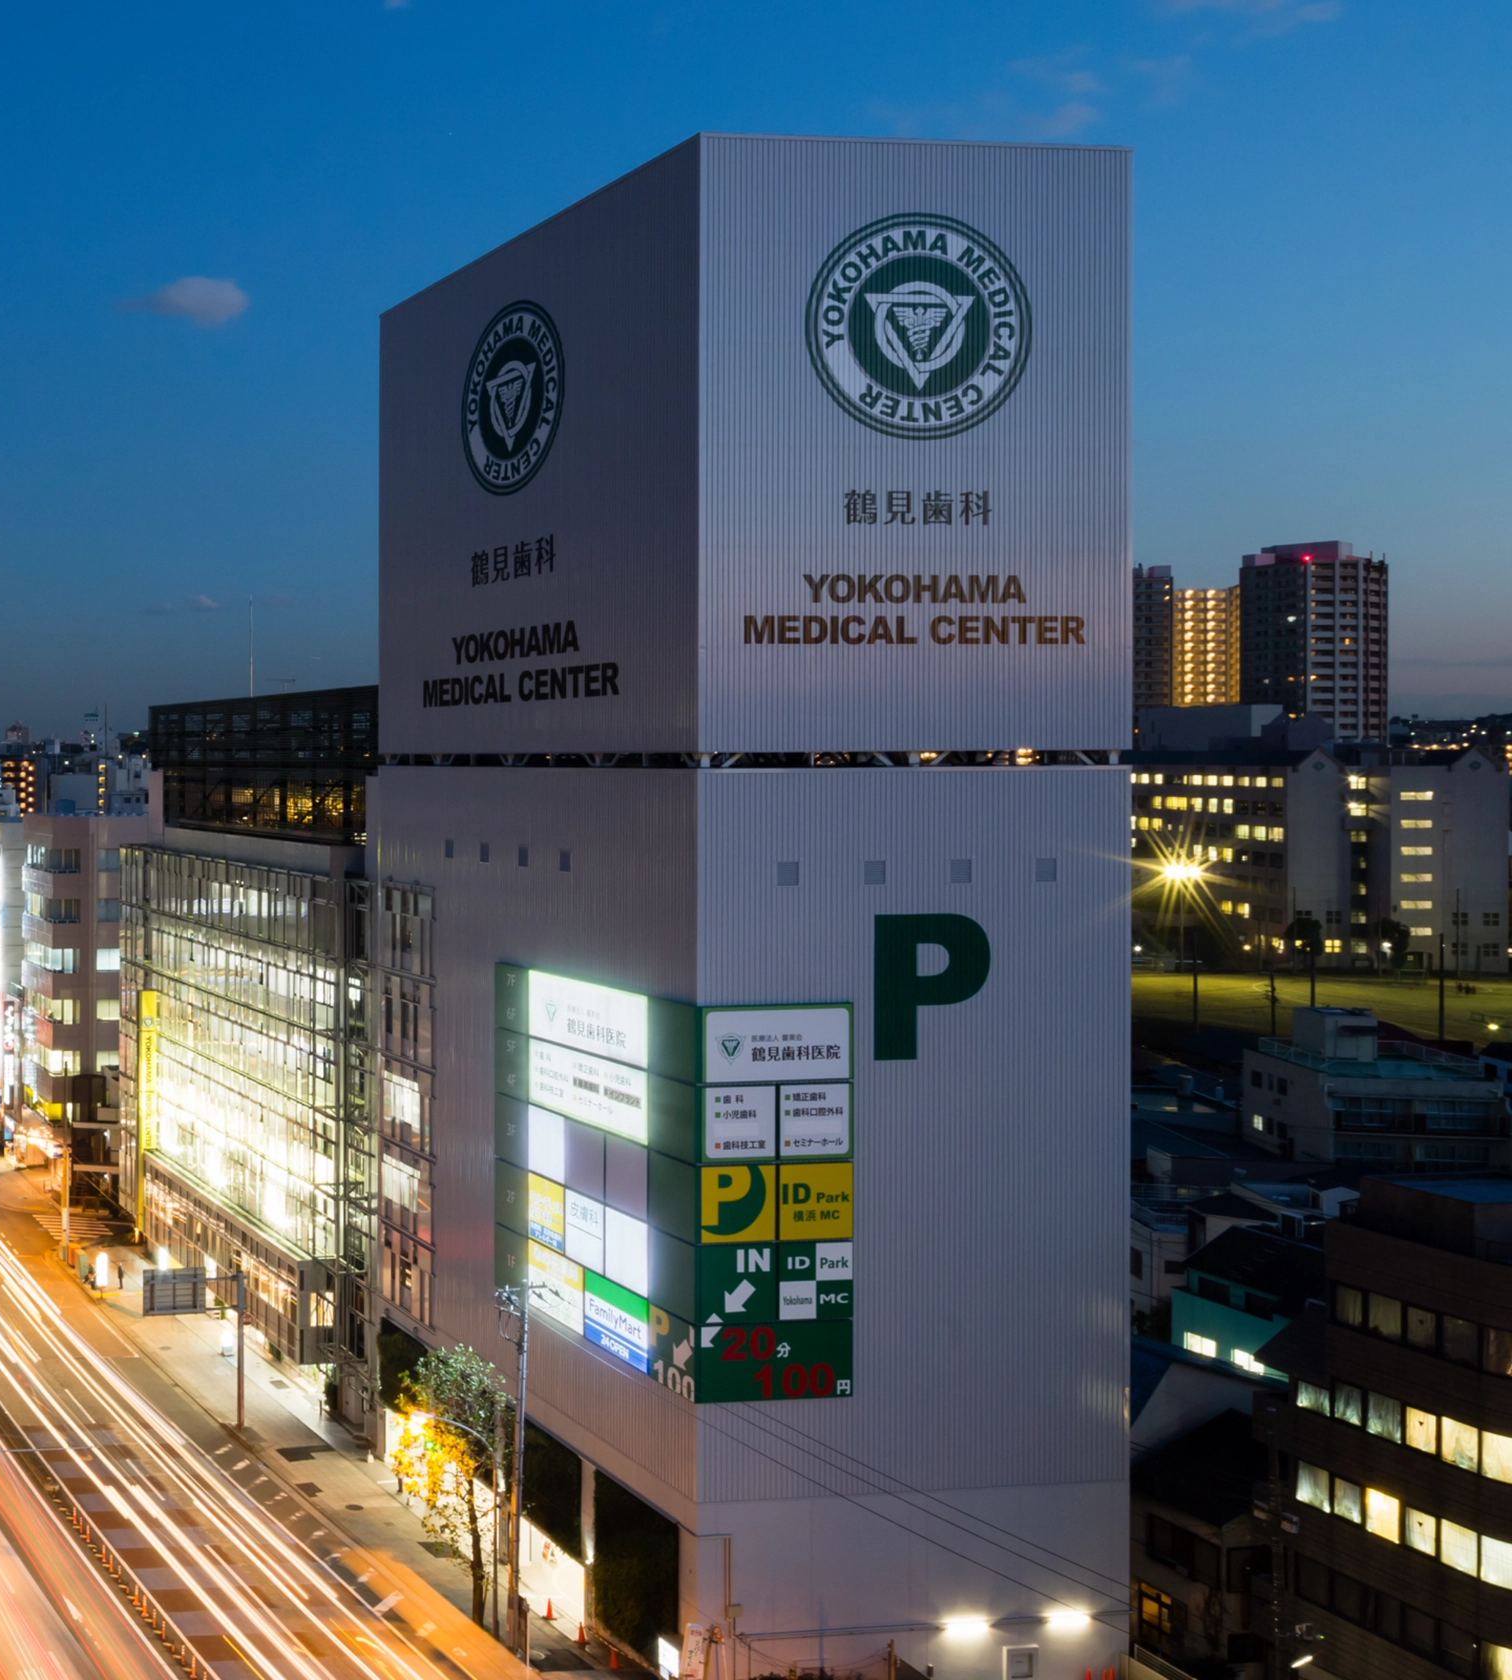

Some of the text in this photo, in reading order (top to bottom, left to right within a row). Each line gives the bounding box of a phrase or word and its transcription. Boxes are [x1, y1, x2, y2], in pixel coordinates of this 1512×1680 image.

[822, 230, 1016, 424] YOKOHAMA MEDICAL CENTER
[467, 315, 558, 482] YOKOHAMA MEDICAL CENTER
[843, 489, 992, 526] 鶴見歯科
[471, 534, 556, 588] 鶴見歯科
[802, 573, 1027, 604] YOKOHAMA
[743, 614, 1087, 645] MEDICAL CENTER
[452, 620, 580, 665] YOKOHAMA
[423, 662, 620, 708] MEDICAL CENTER
[506, 973, 516, 987] 7F
[874, 913, 991, 1061] P
[506, 1007, 516, 1021] 6F
[567, 1017, 627, 1049] 鶴見歯科医院
[506, 1040, 516, 1052] 5F
[751, 1044, 841, 1062] 鶴見歯科医院
[144, 1036, 152, 1083] YOKOHAMA
[506, 1074, 516, 1087] 4F
[609, 1073, 631, 1087] 小児歯科
[578, 1096, 613, 1115] セミナーホール
[792, 1092, 826, 1102] 矯正歯科
[723, 1110, 757, 1119] 小児歯科
[792, 1106, 844, 1117] 歯科口腔外科
[506, 1123, 516, 1136] 3F
[723, 1139, 766, 1150] 歯科技工室
[793, 1137, 843, 1148] セミナーホール
[506, 1189, 515, 1203] 2F
[701, 1166, 752, 1226] P
[782, 1182, 850, 1205] ID Park
[569, 1201, 599, 1229] 皮膚科
[793, 1210, 840, 1222] 横浜 MC
[507, 1254, 516, 1268] 1F
[736, 1248, 771, 1273] IN
[787, 1256, 849, 1270] ID Park
[782, 1293, 849, 1306] Yokohama MC
[589, 1298, 642, 1340] FamilyMart
[650, 1303, 670, 1347] P
